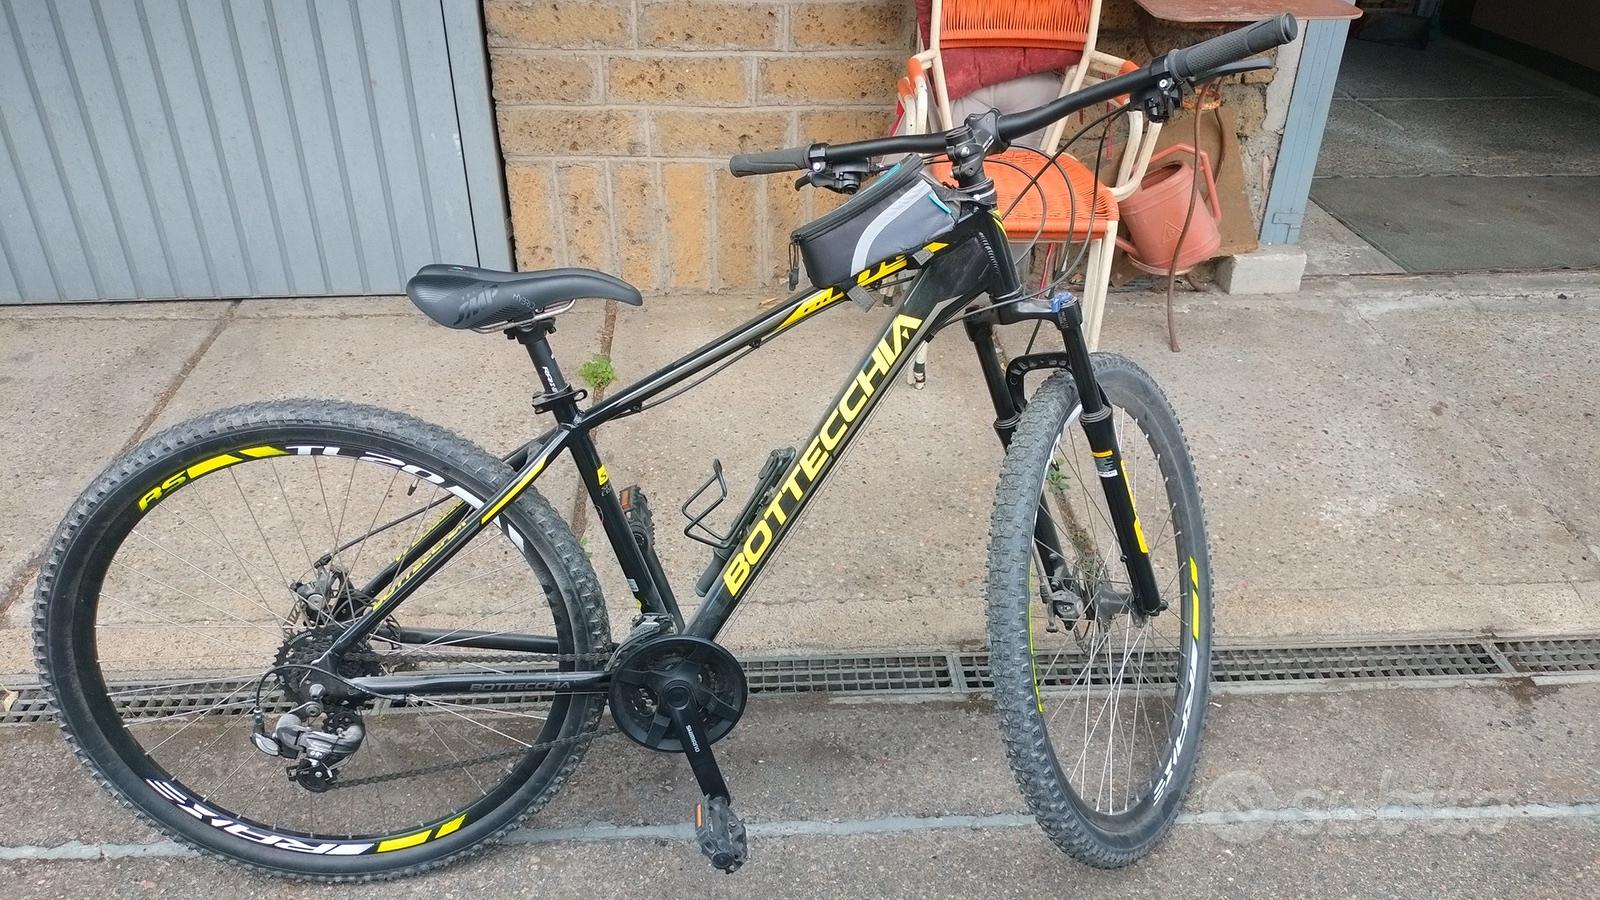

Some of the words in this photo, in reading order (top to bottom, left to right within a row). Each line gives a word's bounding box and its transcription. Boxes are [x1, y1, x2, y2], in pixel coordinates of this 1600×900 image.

[722, 313, 923, 597] BOTTECCHIA
[138, 470, 187, 512] RS
[358, 451, 446, 485] 20
[469, 680, 571, 692] BOTTECCHIA
[685, 724, 701, 753] SHIMANO
